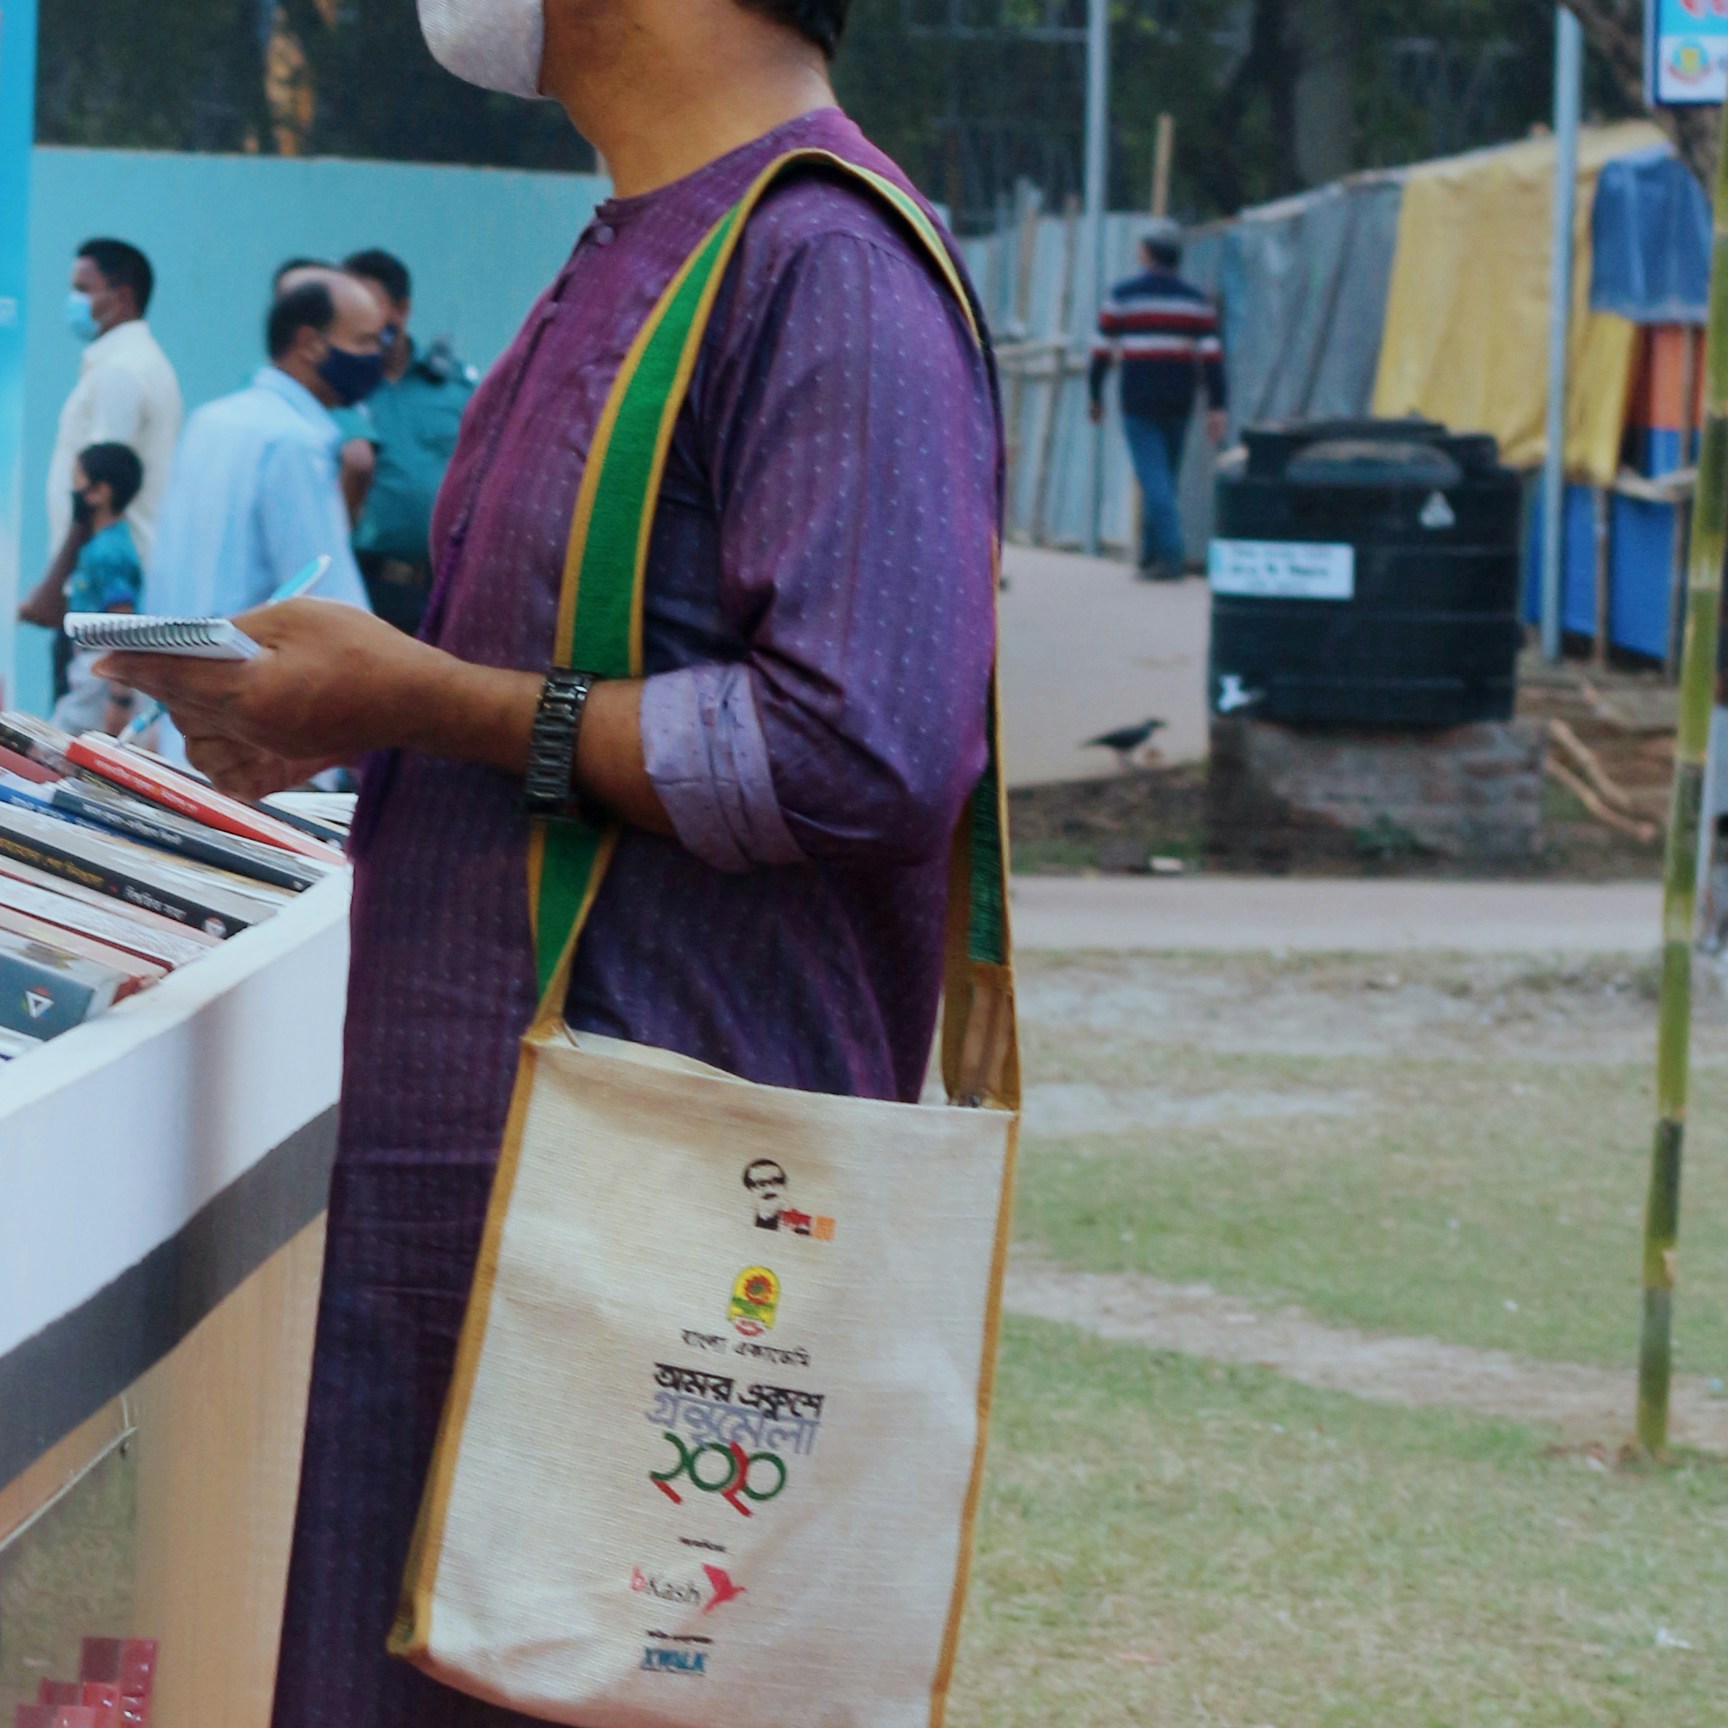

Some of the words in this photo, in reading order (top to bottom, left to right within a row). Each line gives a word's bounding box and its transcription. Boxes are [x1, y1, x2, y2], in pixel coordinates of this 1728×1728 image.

[644, 1390, 823, 1456] গ্রন্থমেলা
[653, 1361, 735, 1404] অমর
[737, 1383, 826, 1422] একুশে
[649, 1432, 788, 1518] ২০২০
